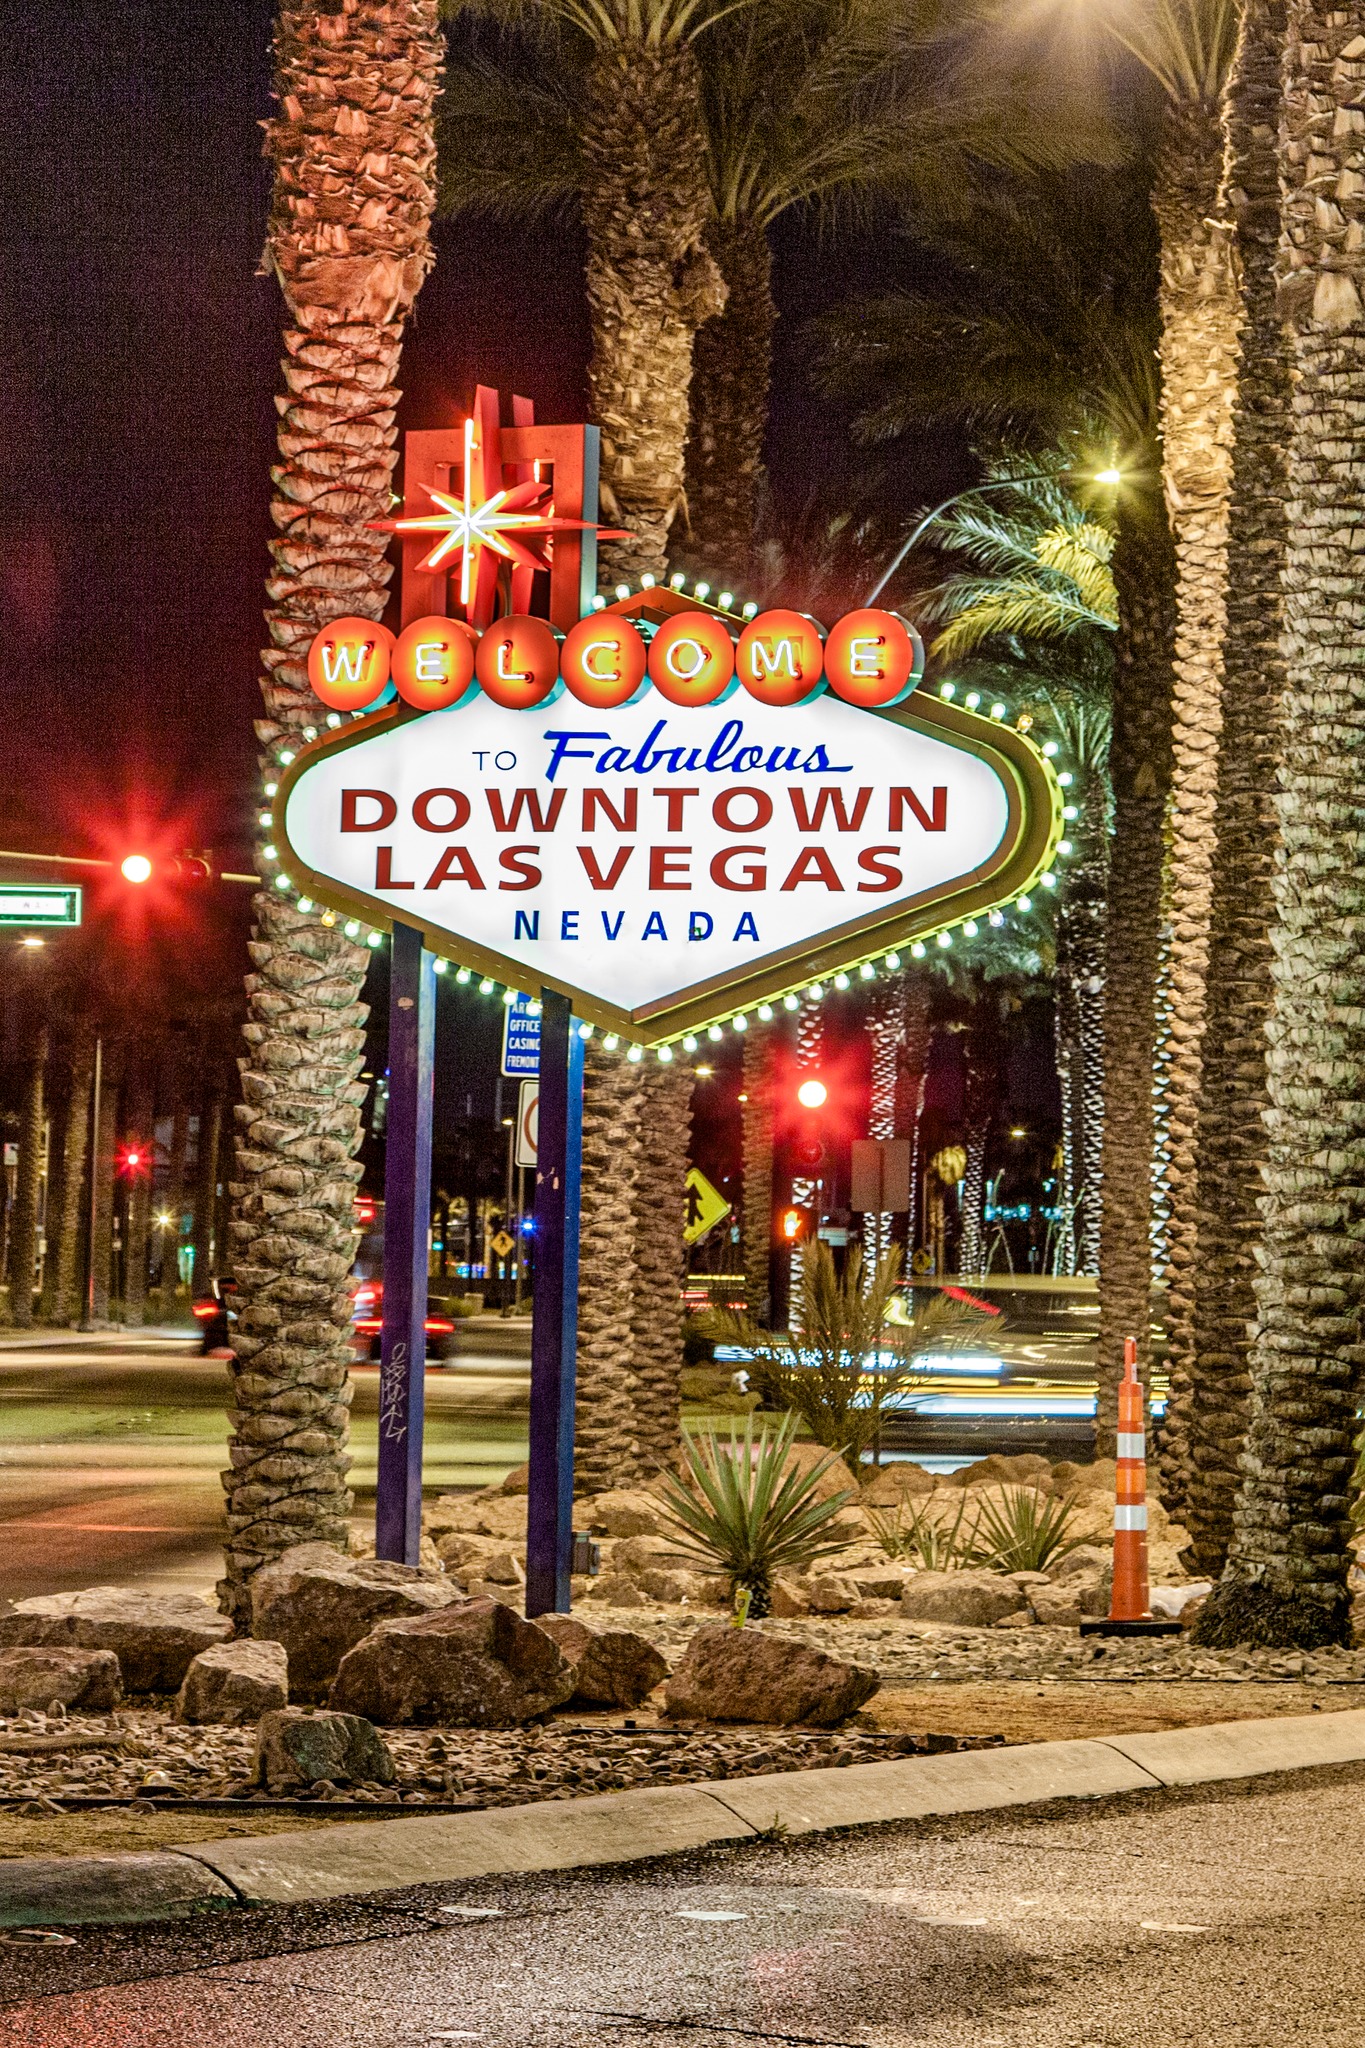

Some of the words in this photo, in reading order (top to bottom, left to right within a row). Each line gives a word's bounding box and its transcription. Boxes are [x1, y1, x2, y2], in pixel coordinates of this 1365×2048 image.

[321, 634, 886, 684] WELCOME
[472, 750, 517, 771] TO
[543, 719, 854, 783] Fabulous
[340, 786, 948, 833] DOWNTOWN
[375, 845, 543, 891] LAS
[576, 845, 903, 892] VEGAS
[514, 910, 760, 941] NEVADA
[506, 1055, 540, 1069] FREMONT
